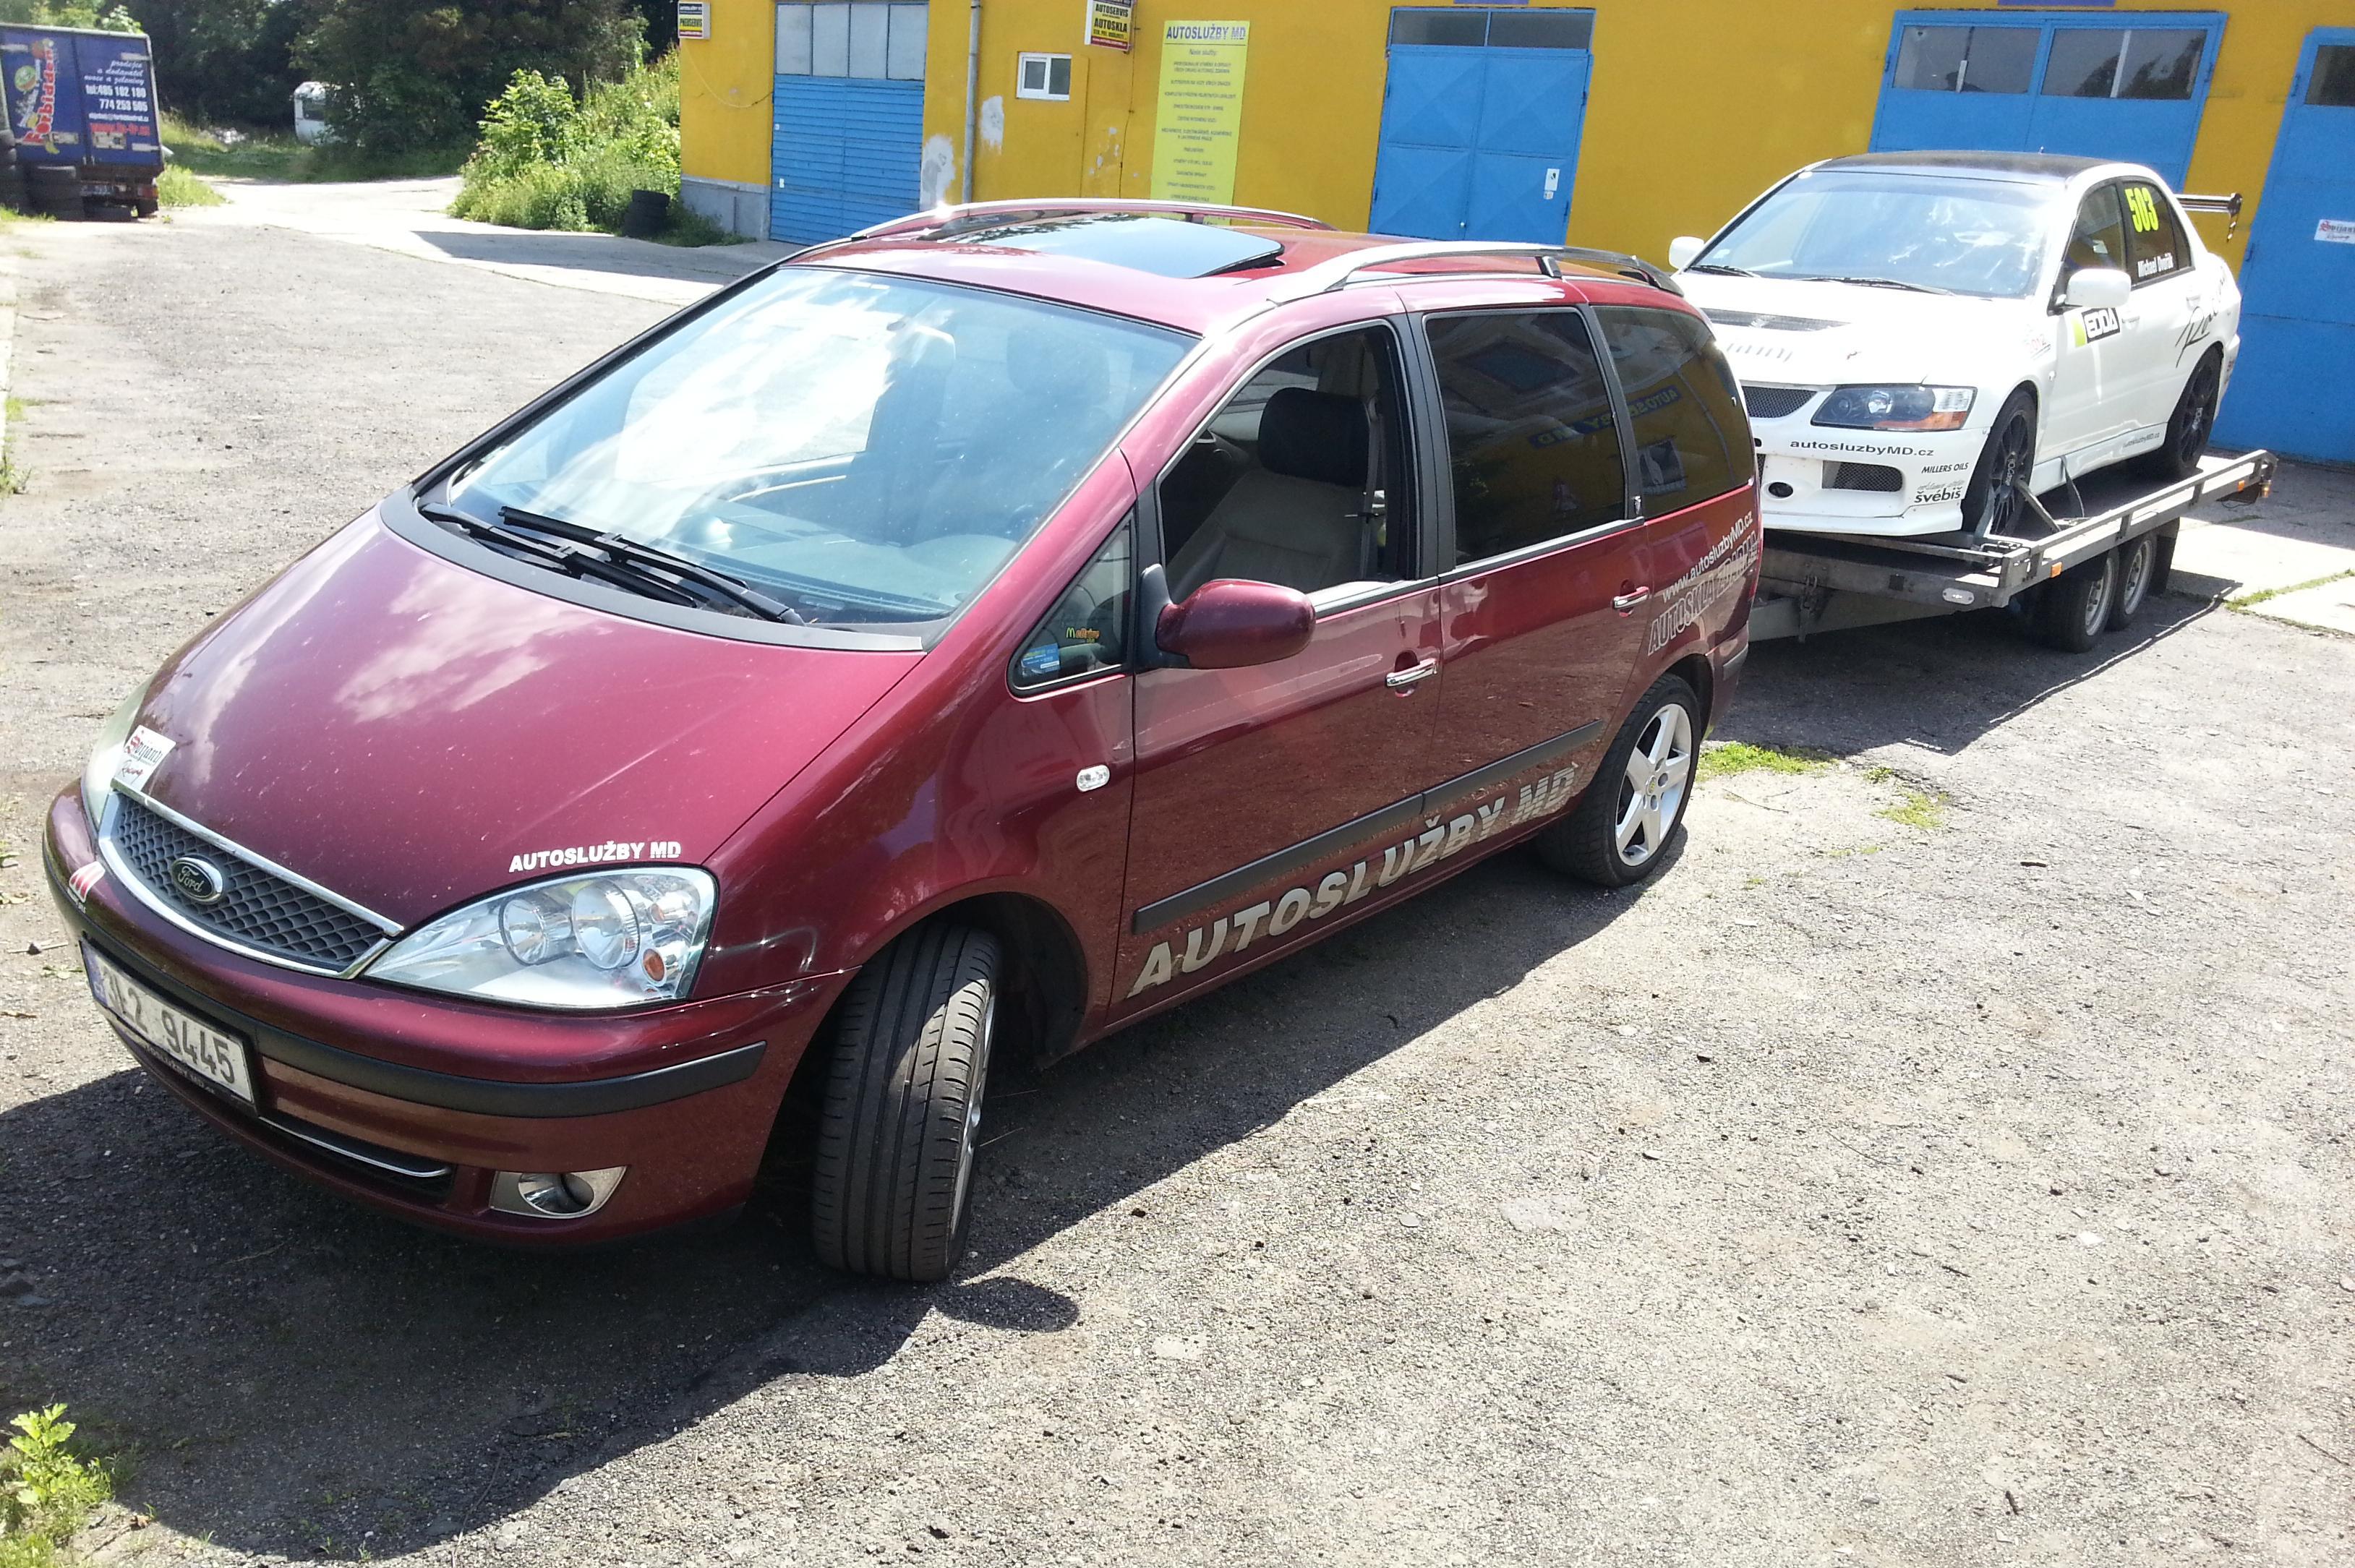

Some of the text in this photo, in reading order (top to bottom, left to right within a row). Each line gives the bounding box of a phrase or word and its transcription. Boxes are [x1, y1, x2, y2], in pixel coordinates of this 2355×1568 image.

[1095, 3, 1129, 17] AUTOSERVIS
[1094, 17, 1127, 33] AUTOSKLA
[1166, 23, 1246, 40] AUTOSLUŽBY MD
[99, 98, 115, 110] 774
[2125, 187, 2159, 233] 503
[1790, 440, 1935, 457] autosluzbyMD.cz
[1921, 462, 1969, 474] MILLERS OILS
[1914, 486, 1963, 503] švébiš
[1662, 510, 1754, 603] www.autosluzbyMD.cz
[1647, 575, 1716, 657] AUTOSKLA
[508, 840, 682, 873] AUTOSLUŽBY MD
[178, 865, 207, 893] Ford
[1127, 766, 1576, 998] AUTOSLUŽBY MD
[161, 1009, 236, 1085] 9445
